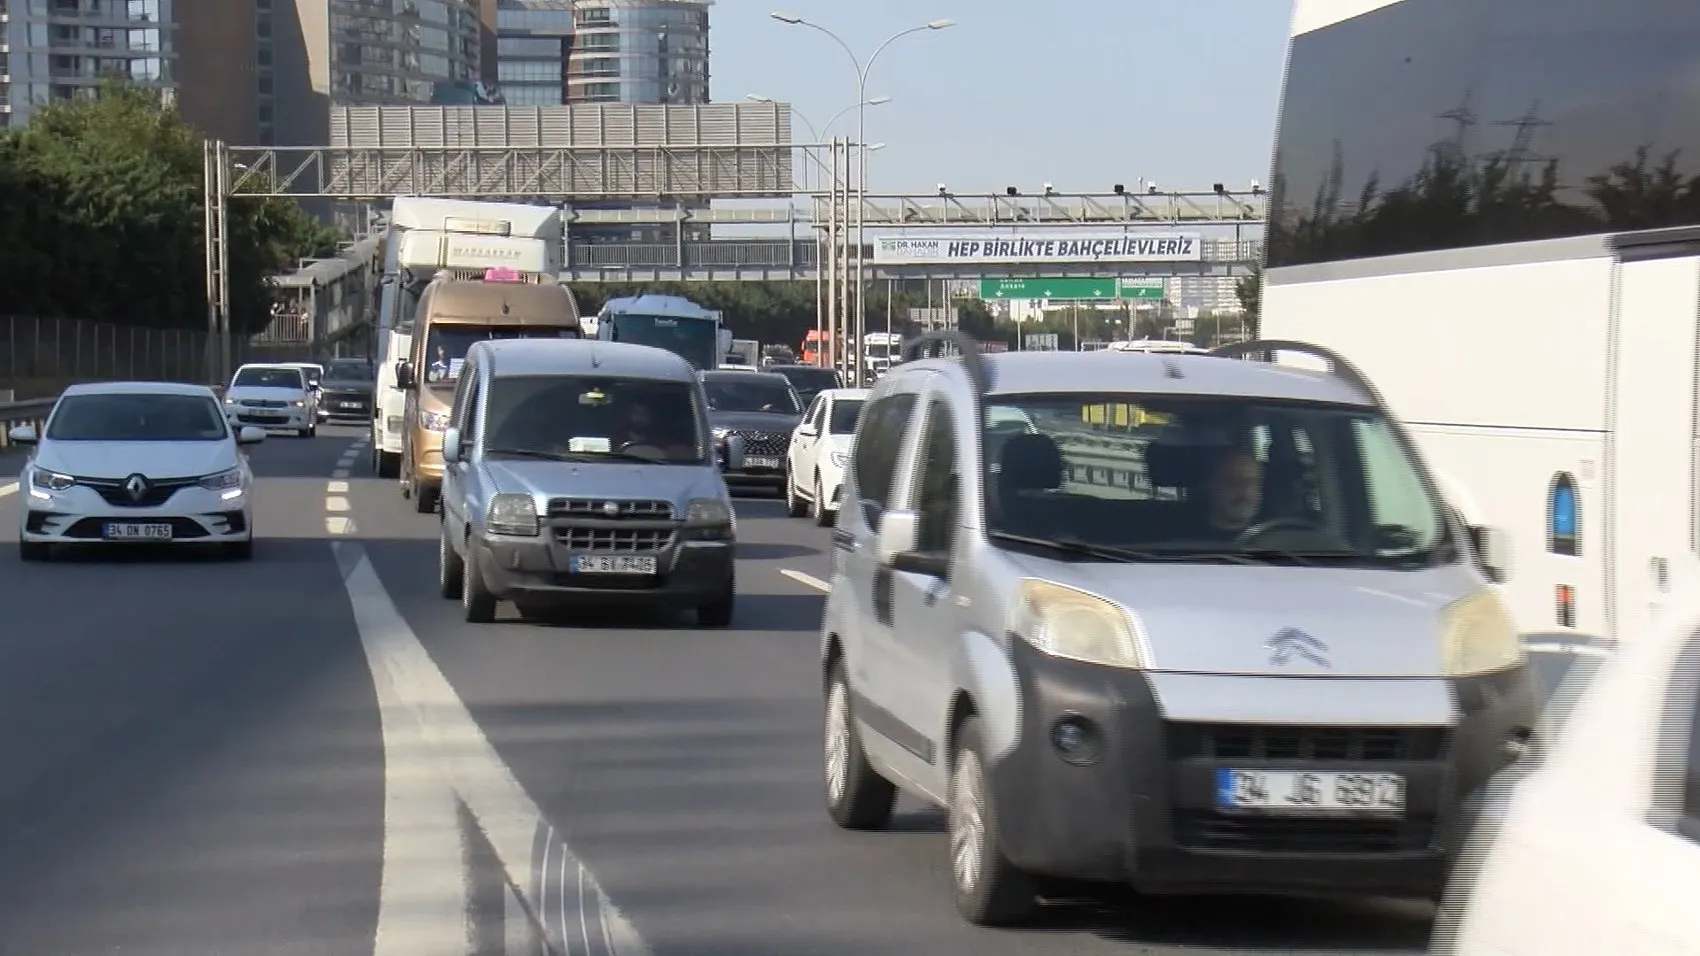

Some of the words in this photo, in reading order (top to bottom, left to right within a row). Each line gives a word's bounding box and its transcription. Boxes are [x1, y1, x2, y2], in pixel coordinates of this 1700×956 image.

[897, 241, 910, 249] DR.
[911, 241, 939, 249] HAKAN
[948, 241, 980, 257] HEP
[983, 237, 1054, 257] BİRLİKTE
[1058, 236, 1193, 259] BAHÇELİEVLERİZ
[110, 525, 122, 535] 34
[144, 525, 170, 537] 0765
[579, 556, 595, 569] 34
[1235, 772, 1269, 804] 34
